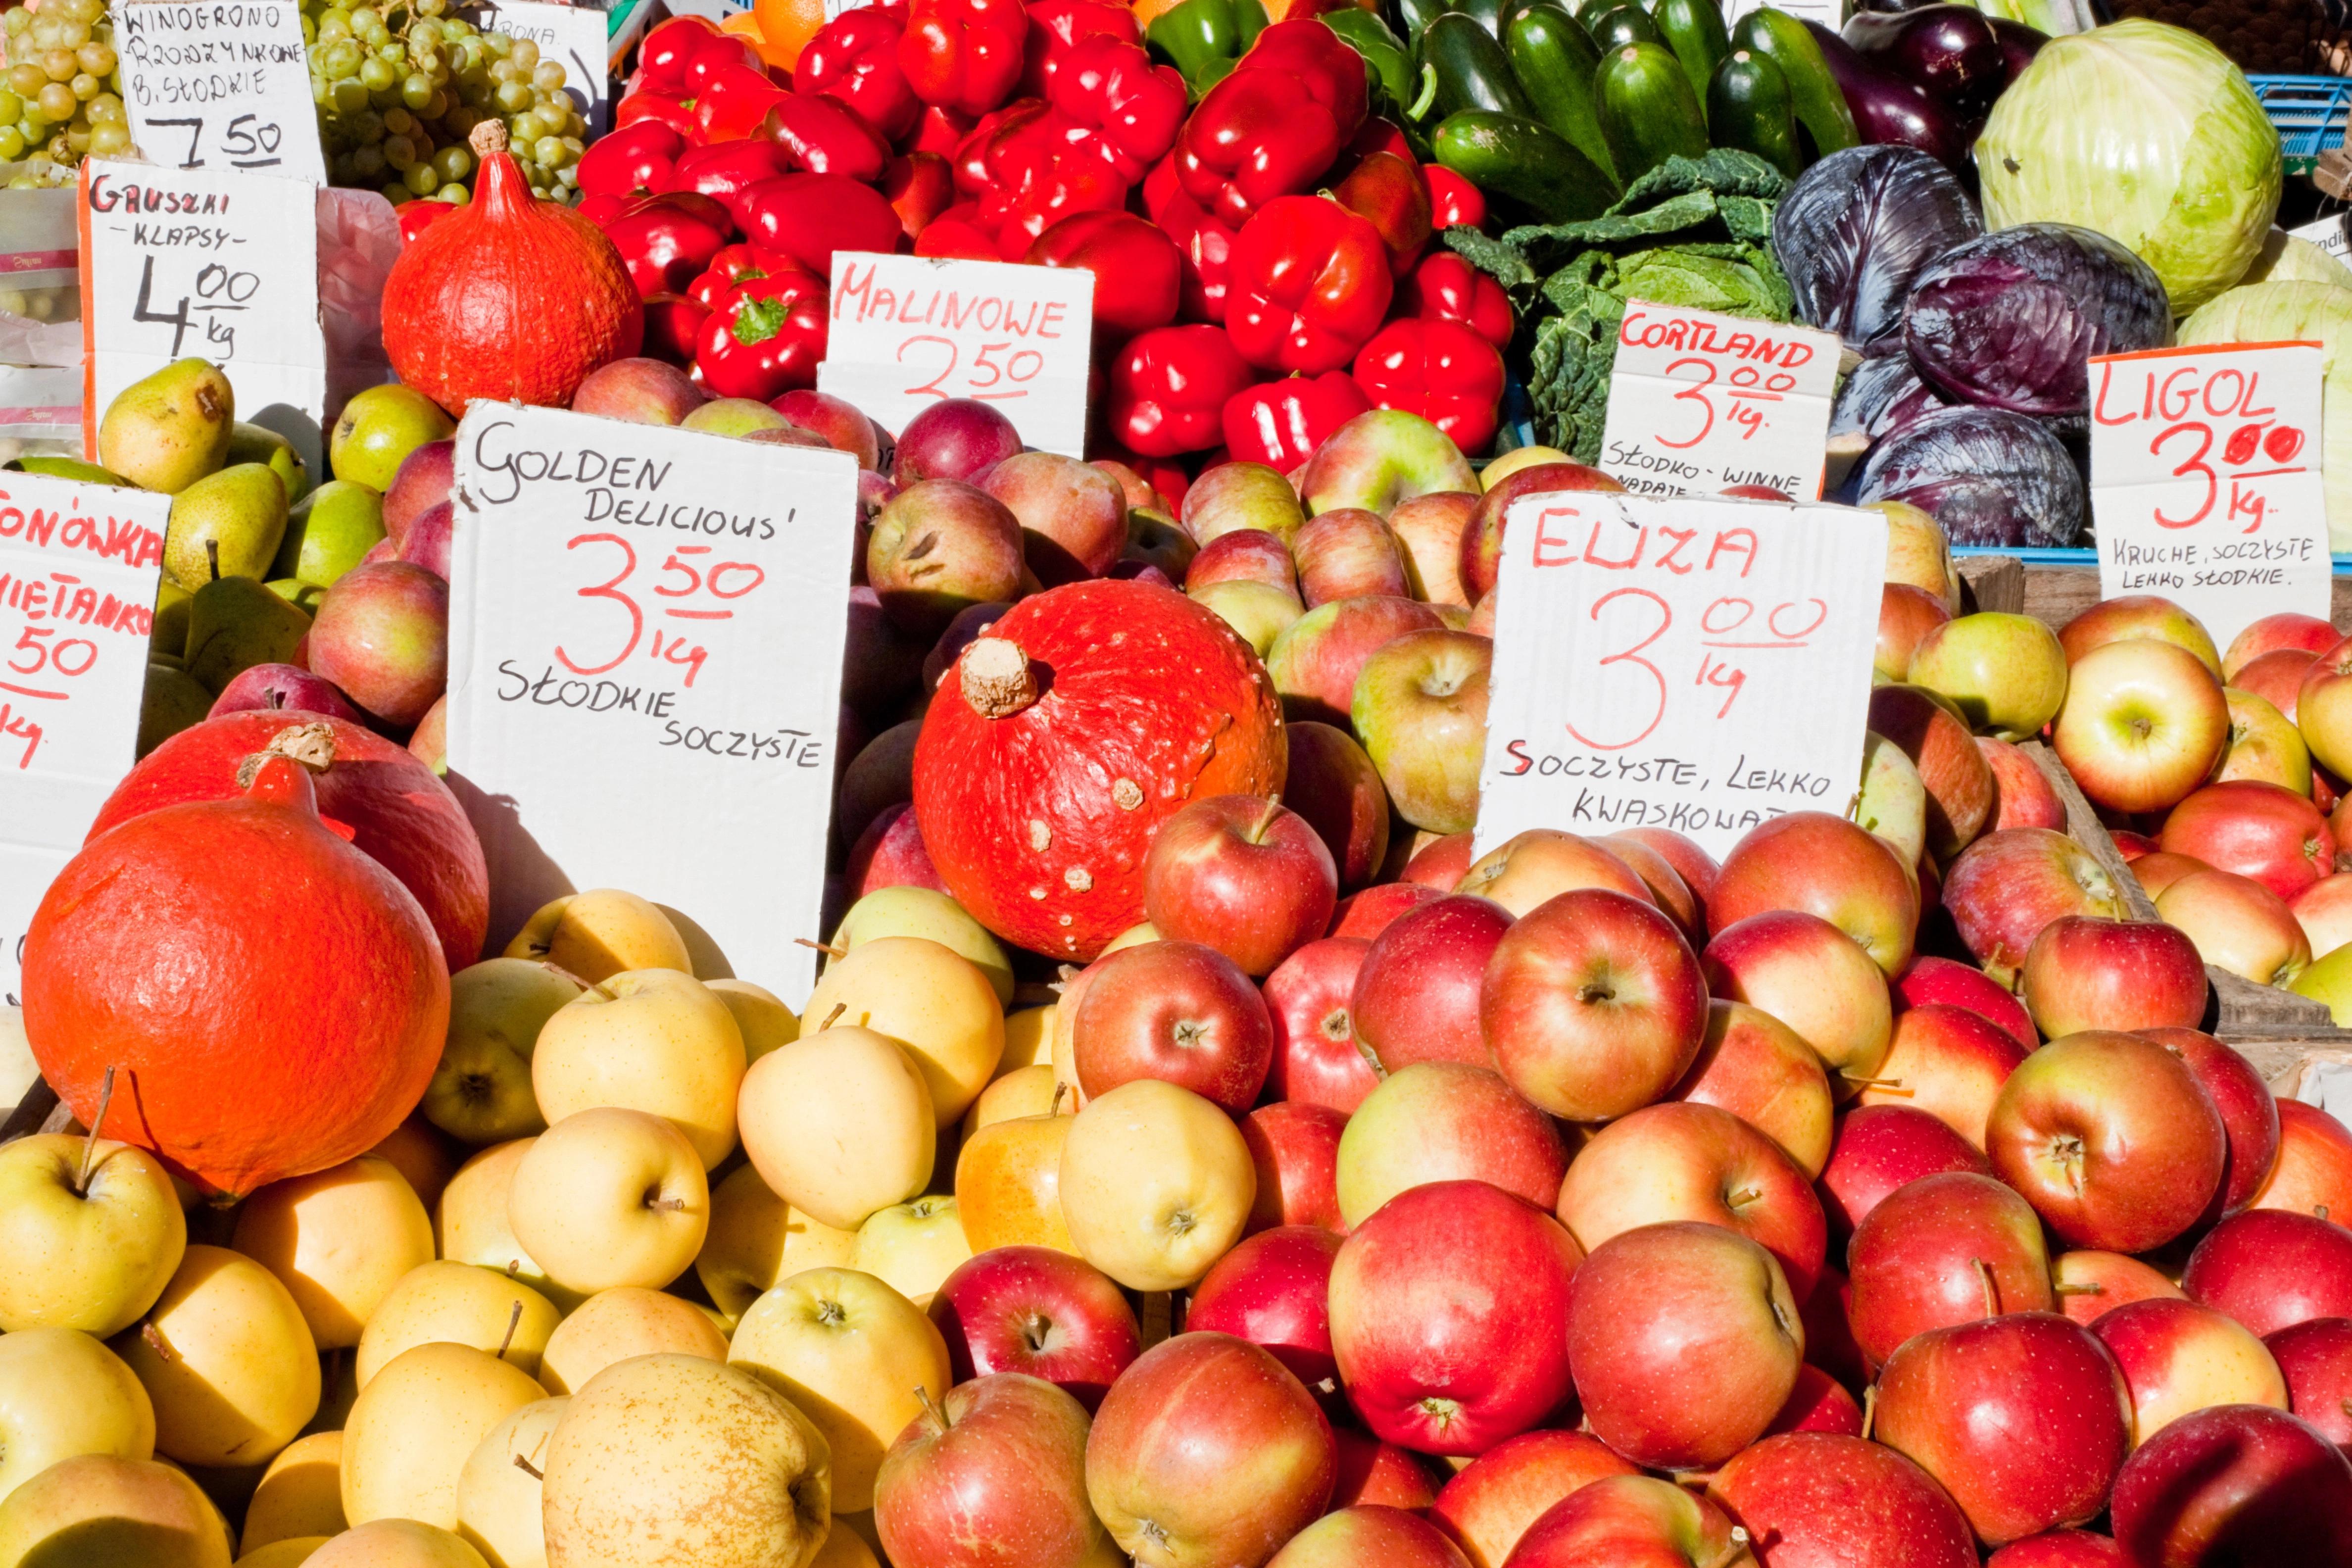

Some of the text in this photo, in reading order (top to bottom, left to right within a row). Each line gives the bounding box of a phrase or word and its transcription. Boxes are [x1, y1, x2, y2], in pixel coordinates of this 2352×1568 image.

[124, 5, 280, 34] WINOGRONO
[145, 114, 281, 168] 7 50
[89, 173, 230, 214] GRUSZKI
[133, 254, 260, 363] 4 00
[833, 261, 1067, 339] MALINOWE
[207, 316, 235, 360] kg
[897, 335, 1043, 400] 2 50
[1619, 312, 1813, 368] CORTLAND
[1655, 357, 1797, 449] 3 00
[2094, 362, 2276, 426] LIGOL
[475, 421, 673, 504] GOLDEN
[2150, 419, 2306, 529] 3 00
[1533, 506, 1760, 579] ELIZA
[2212, 538, 2314, 561] SOCZYSTE
[554, 532, 765, 676] 3 50
[2123, 571, 2183, 588] LEKKO
[8, 626, 98, 676] 50
[1566, 587, 1828, 751] 3 00
[497, 659, 677, 719] SŁODKIE
[659, 721, 822, 768] SOCZYSTE
[1727, 754, 1830, 797] LEKKO
